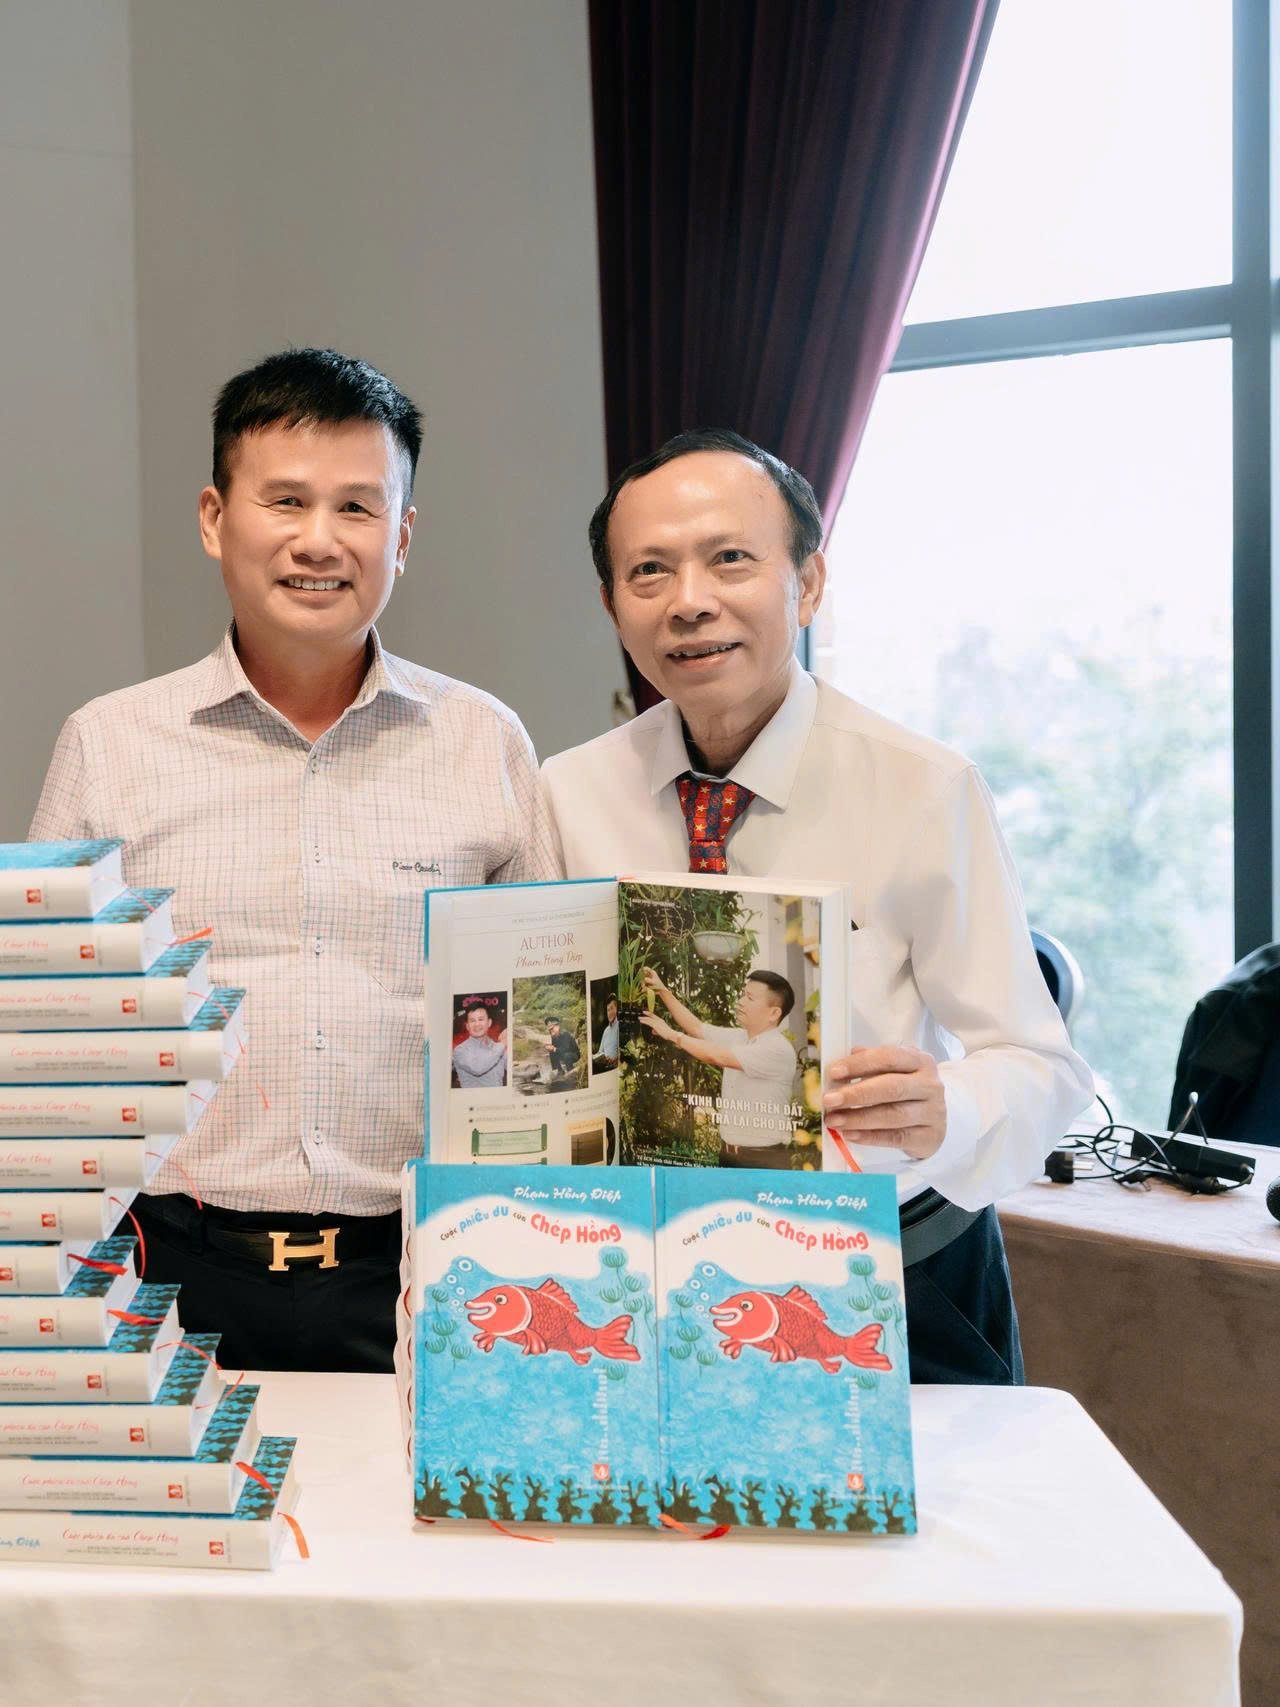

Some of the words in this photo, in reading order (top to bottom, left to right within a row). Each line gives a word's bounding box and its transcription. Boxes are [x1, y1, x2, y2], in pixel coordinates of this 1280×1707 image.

[520, 932, 574, 950] AUTHOR
[716, 1097, 750, 1112] DOANH
[733, 1116, 749, 1130] LẠI
[753, 1118, 774, 1129] CHO
[513, 1186, 549, 1200] Phạm
[553, 1187, 587, 1203] Hồng
[590, 1188, 621, 1204] Điệp
[757, 1192, 792, 1207] Phạm
[797, 1194, 832, 1210] Hồng
[836, 1195, 867, 1211] Điệp
[459, 1208, 489, 1233] phiêu
[531, 1214, 571, 1244] Chép
[576, 1220, 621, 1243] Hồng
[701, 1213, 732, 1238] phiêu
[775, 1220, 816, 1250] Chép
[822, 1227, 869, 1250] Hồng
